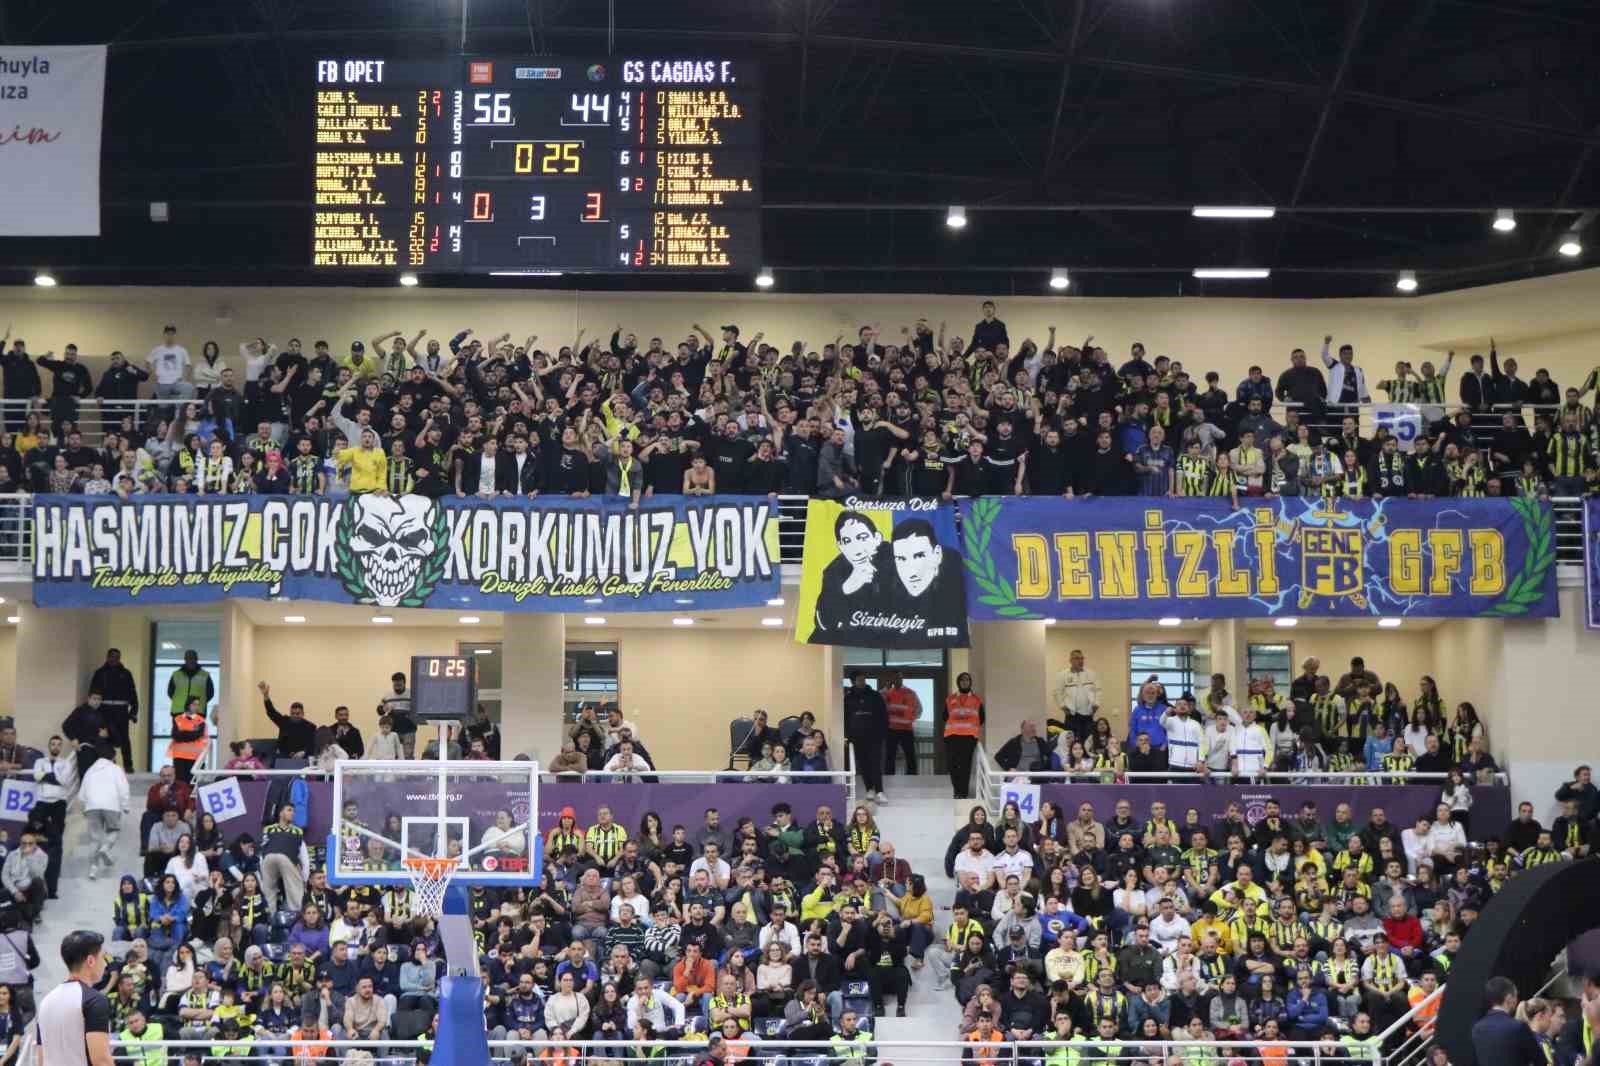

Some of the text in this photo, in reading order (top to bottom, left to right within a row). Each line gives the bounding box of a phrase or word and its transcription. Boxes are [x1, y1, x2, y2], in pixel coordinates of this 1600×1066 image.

[318, 61, 384, 82] FB OPET
[623, 61, 644, 82] GS
[721, 61, 736, 82] F.
[419, 91, 427, 103] 2
[433, 91, 441, 104] 2
[621, 91, 630, 104] 4
[657, 91, 665, 104] 0
[418, 105, 427, 117] 4
[474, 93, 511, 123] 56
[572, 93, 610, 122] 44
[618, 105, 630, 117] 11
[418, 118, 426, 130] 5
[621, 117, 630, 131] 5
[657, 118, 665, 130] 3
[416, 131, 426, 144] 10
[657, 131, 665, 144] 5
[450, 151, 462, 164] 10
[515, 143, 580, 173] 0 25
[620, 151, 630, 165] 6
[450, 165, 461, 178] 10
[620, 177, 630, 191] 9
[634, 177, 644, 191] 2
[657, 178, 665, 191] 8
[453, 192, 461, 204] 4
[473, 192, 491, 220] 0
[530, 196, 545, 221] 3
[586, 192, 601, 220] 3
[409, 225, 425, 238] 21
[450, 225, 461, 239] 14
[620, 225, 630, 239] 5
[409, 239, 425, 252] 22
[430, 239, 440, 252] 2
[452, 239, 461, 253] 3
[409, 252, 425, 265] 33
[620, 252, 630, 266] 4
[634, 252, 644, 266] 2
[650, 252, 664, 266] 34
[909, 497, 938, 511] Dek
[35, 502, 345, 595] HASMIMIZ ÇOK
[445, 506, 772, 583] KORKUMUZ YOK
[1011, 507, 1280, 599] DENİZLİ
[1389, 528, 1506, 596] GFB
[184, 572, 204, 585] en
[1304, 557, 1359, 591] FB
[480, 571, 546, 602] Denizli
[550, 575, 598, 597] Liseli
[602, 576, 645, 598] Genç
[850, 610, 928, 634] Sizinleyiz
[429, 659, 466, 677] 0 25
[5, 789, 34, 812] B2
[207, 787, 237, 814] B3
